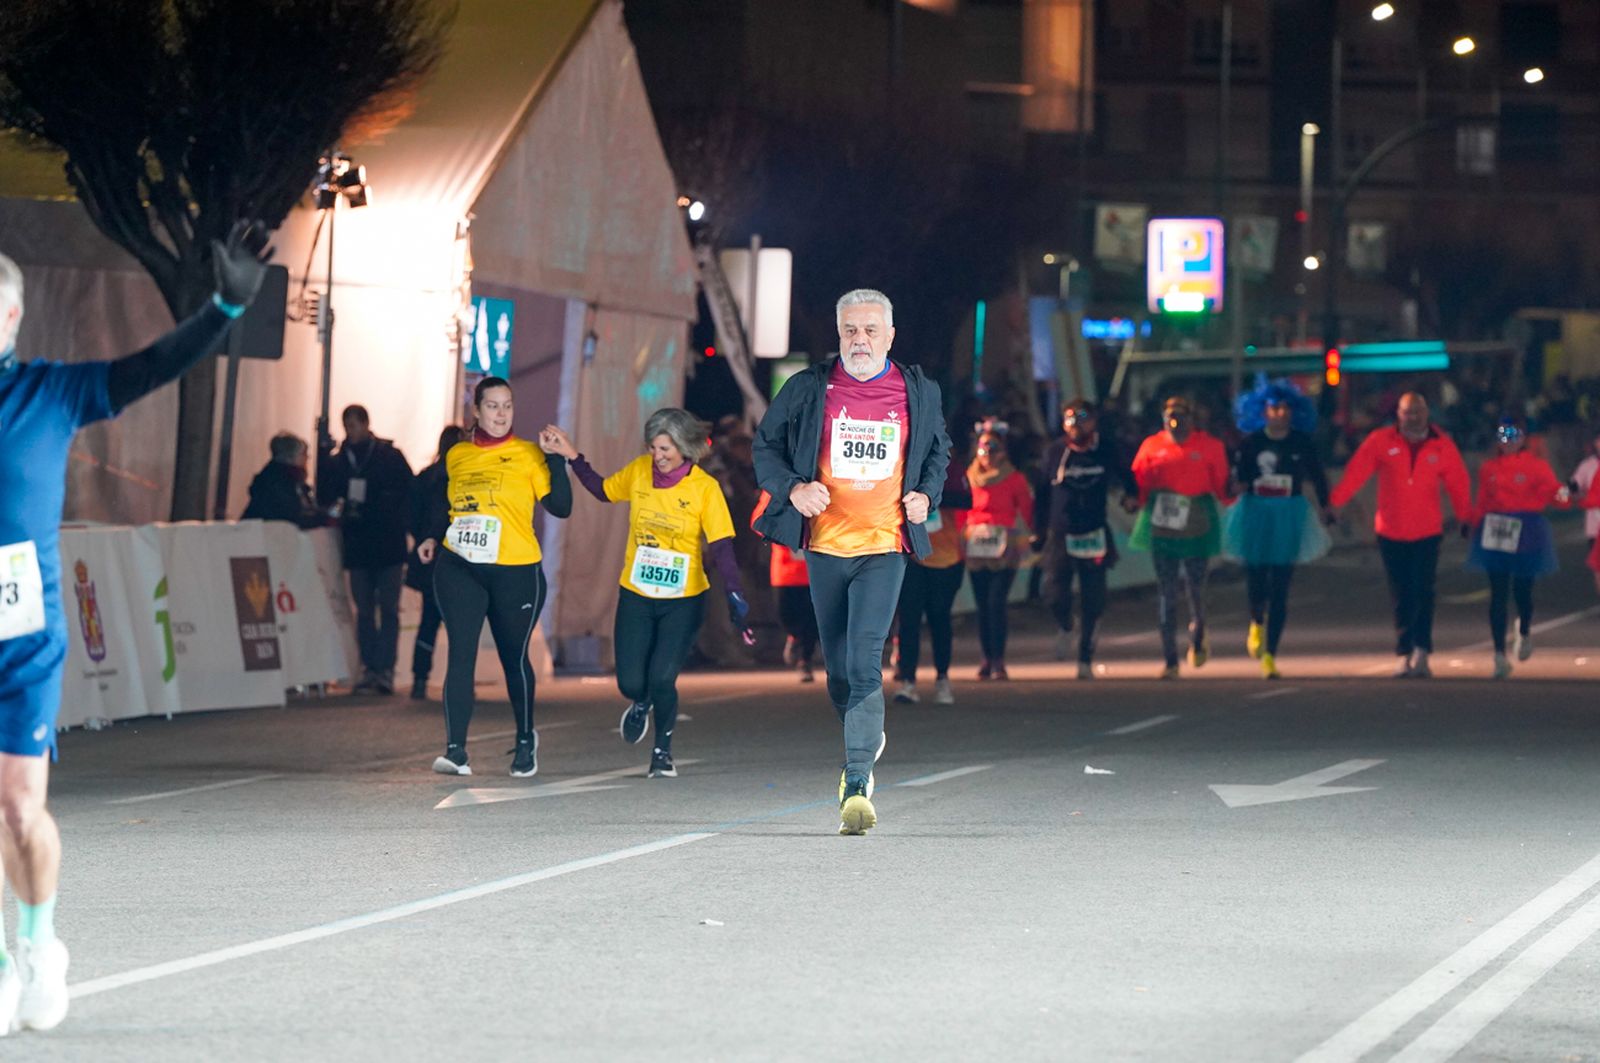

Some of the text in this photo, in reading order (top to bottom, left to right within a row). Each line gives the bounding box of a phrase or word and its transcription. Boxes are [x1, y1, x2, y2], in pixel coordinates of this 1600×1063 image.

[843, 441, 887, 460] 3946
[458, 531, 488, 547] 1448
[640, 565, 680, 584] 13576
[0, 582, 19, 606] 3
